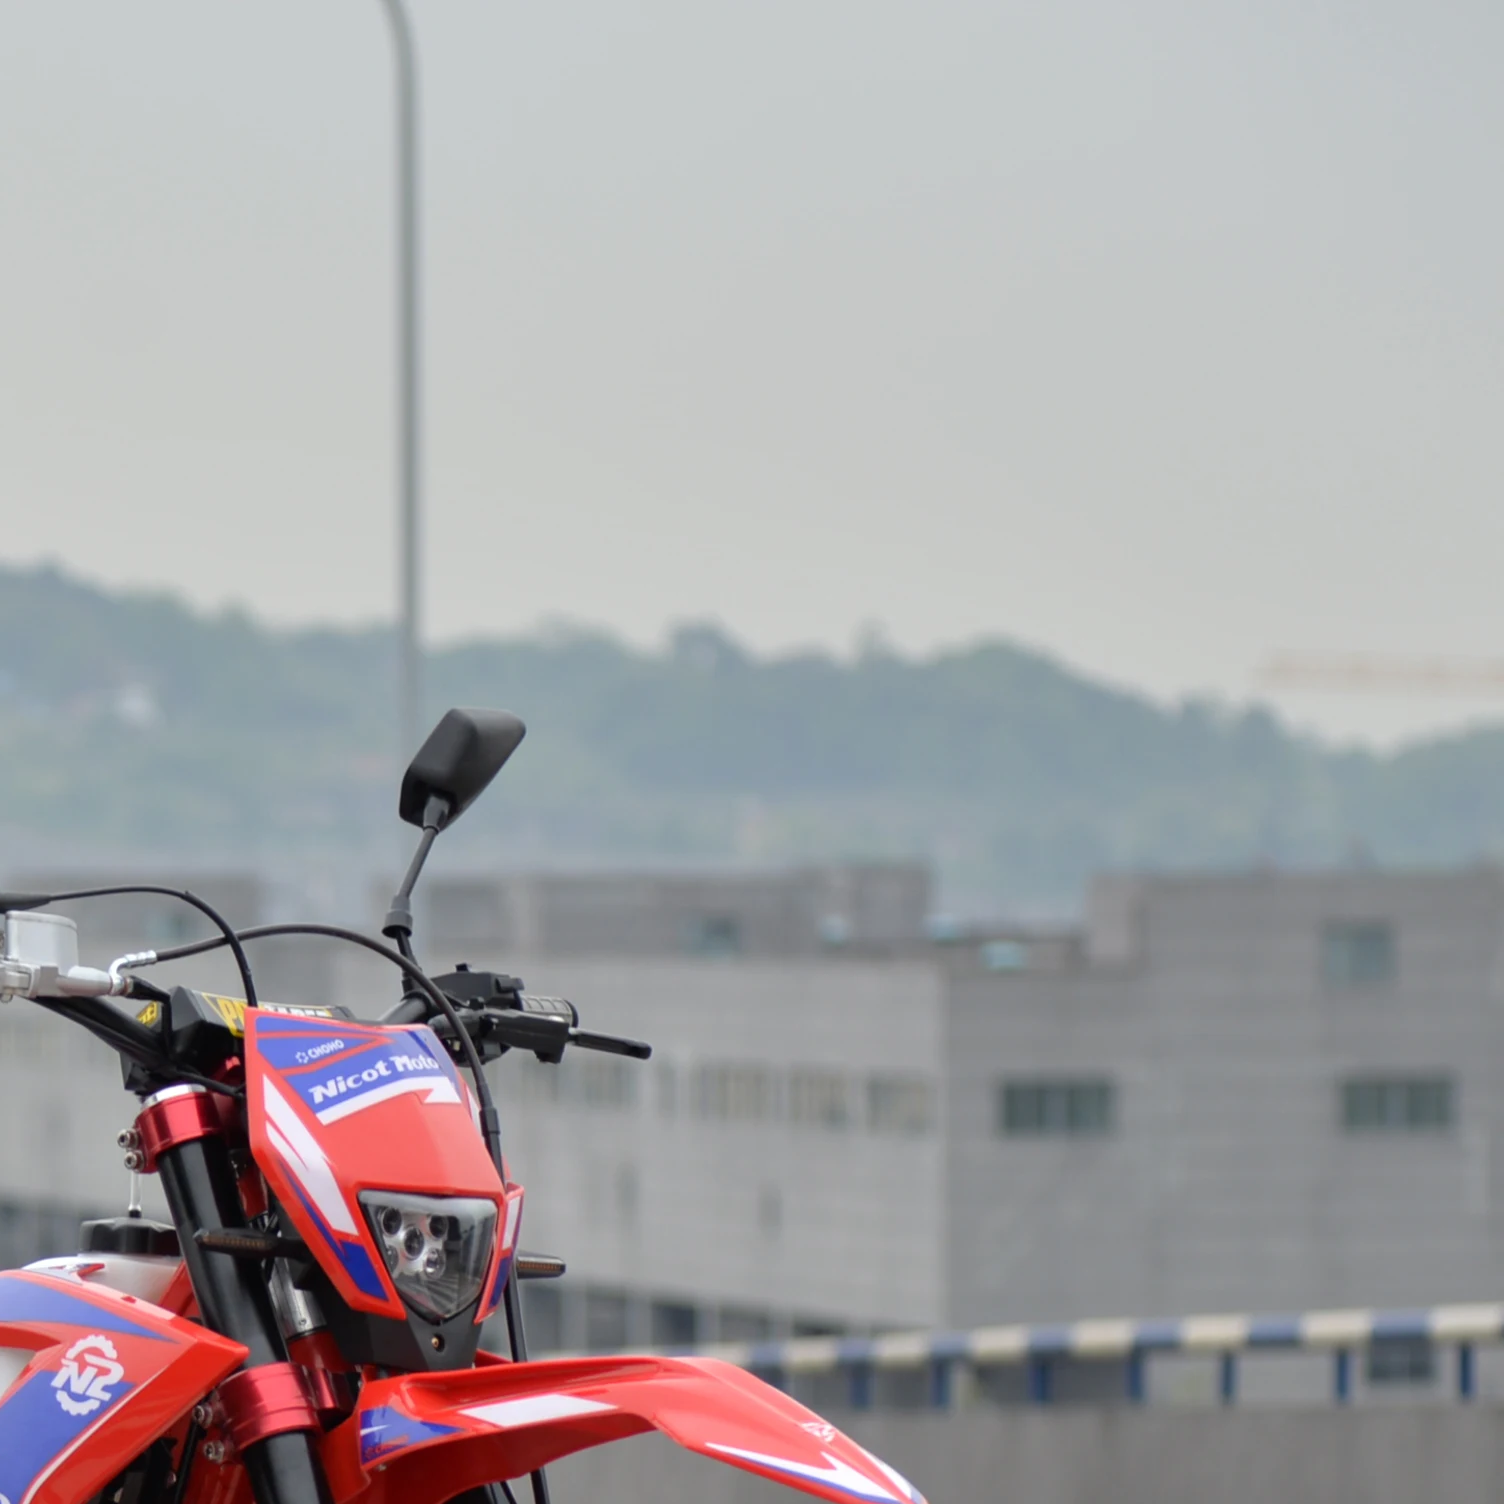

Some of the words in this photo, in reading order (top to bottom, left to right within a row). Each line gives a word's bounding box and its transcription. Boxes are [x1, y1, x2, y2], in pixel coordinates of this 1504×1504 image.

[308, 1039, 345, 1059] CHOHO
[308, 1060, 391, 1104] Nicot
[389, 1054, 439, 1073] Moto
